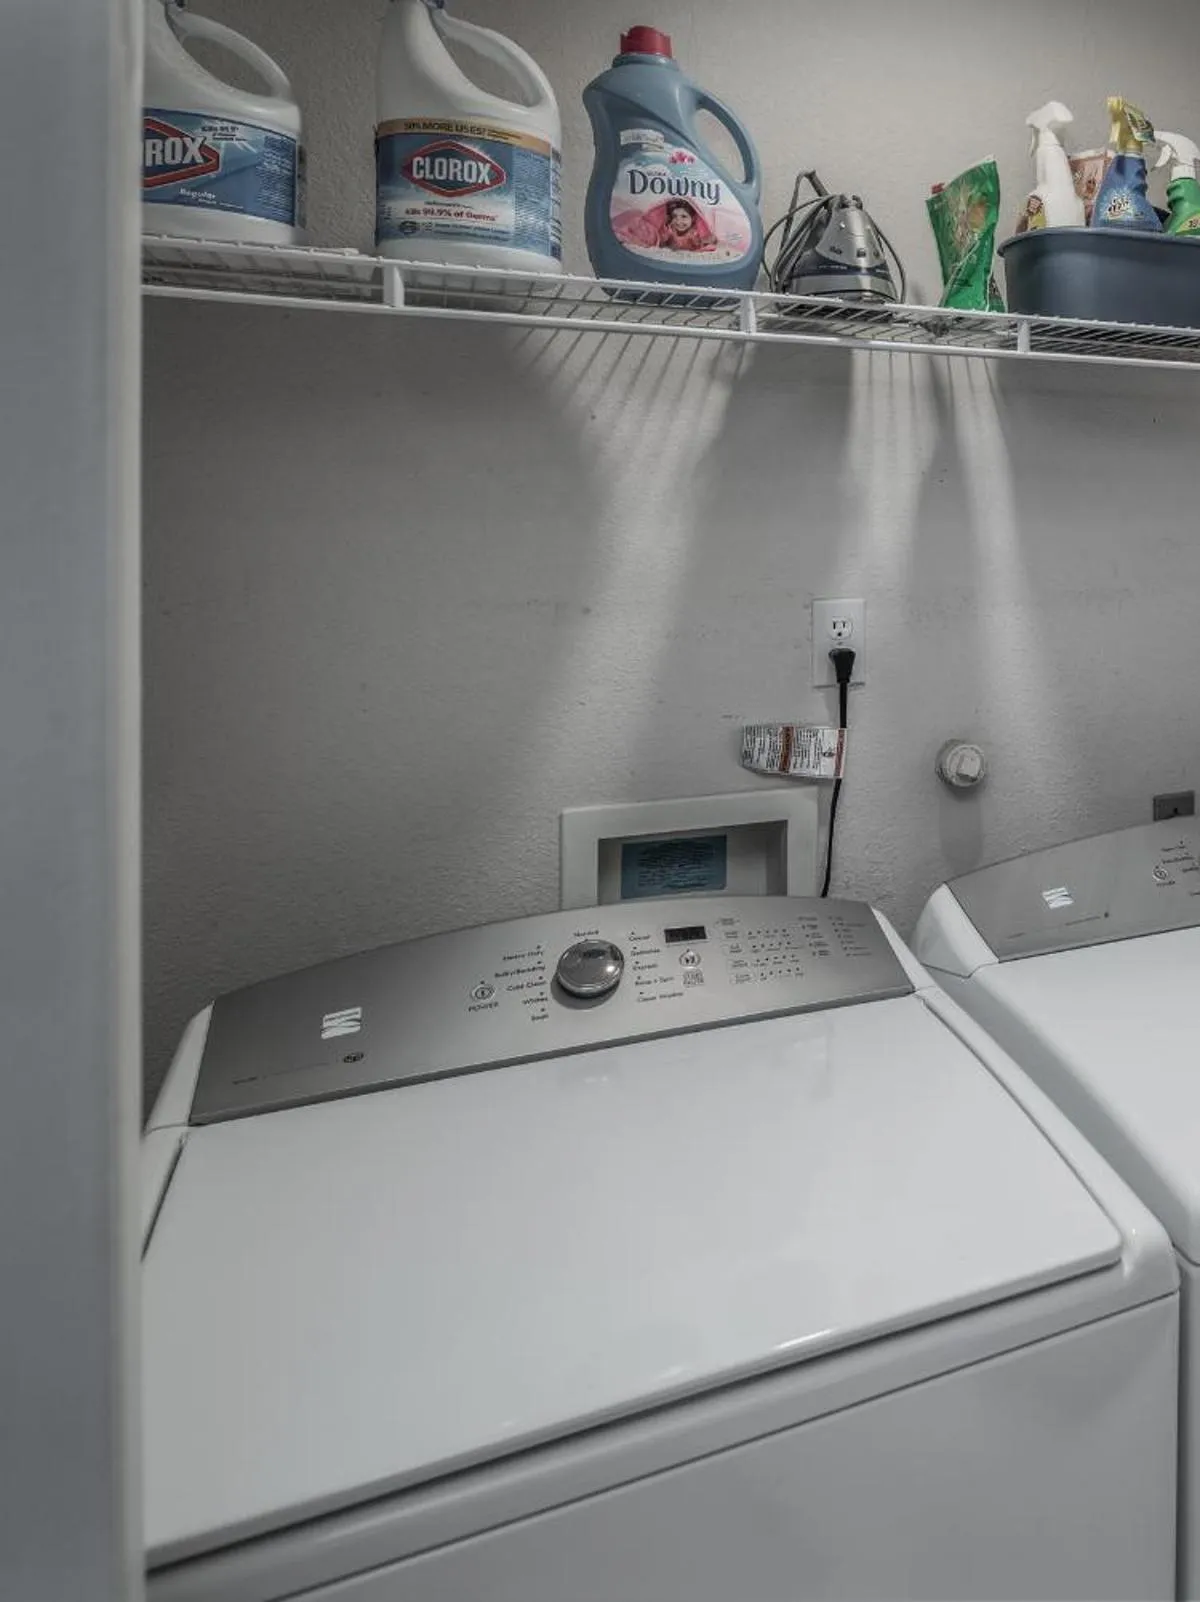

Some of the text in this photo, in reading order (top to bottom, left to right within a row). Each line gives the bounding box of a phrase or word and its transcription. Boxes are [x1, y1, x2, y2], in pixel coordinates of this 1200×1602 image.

[145, 136, 206, 167] ROX
[412, 155, 492, 185] CLOROX
[627, 169, 721, 206] Downy
